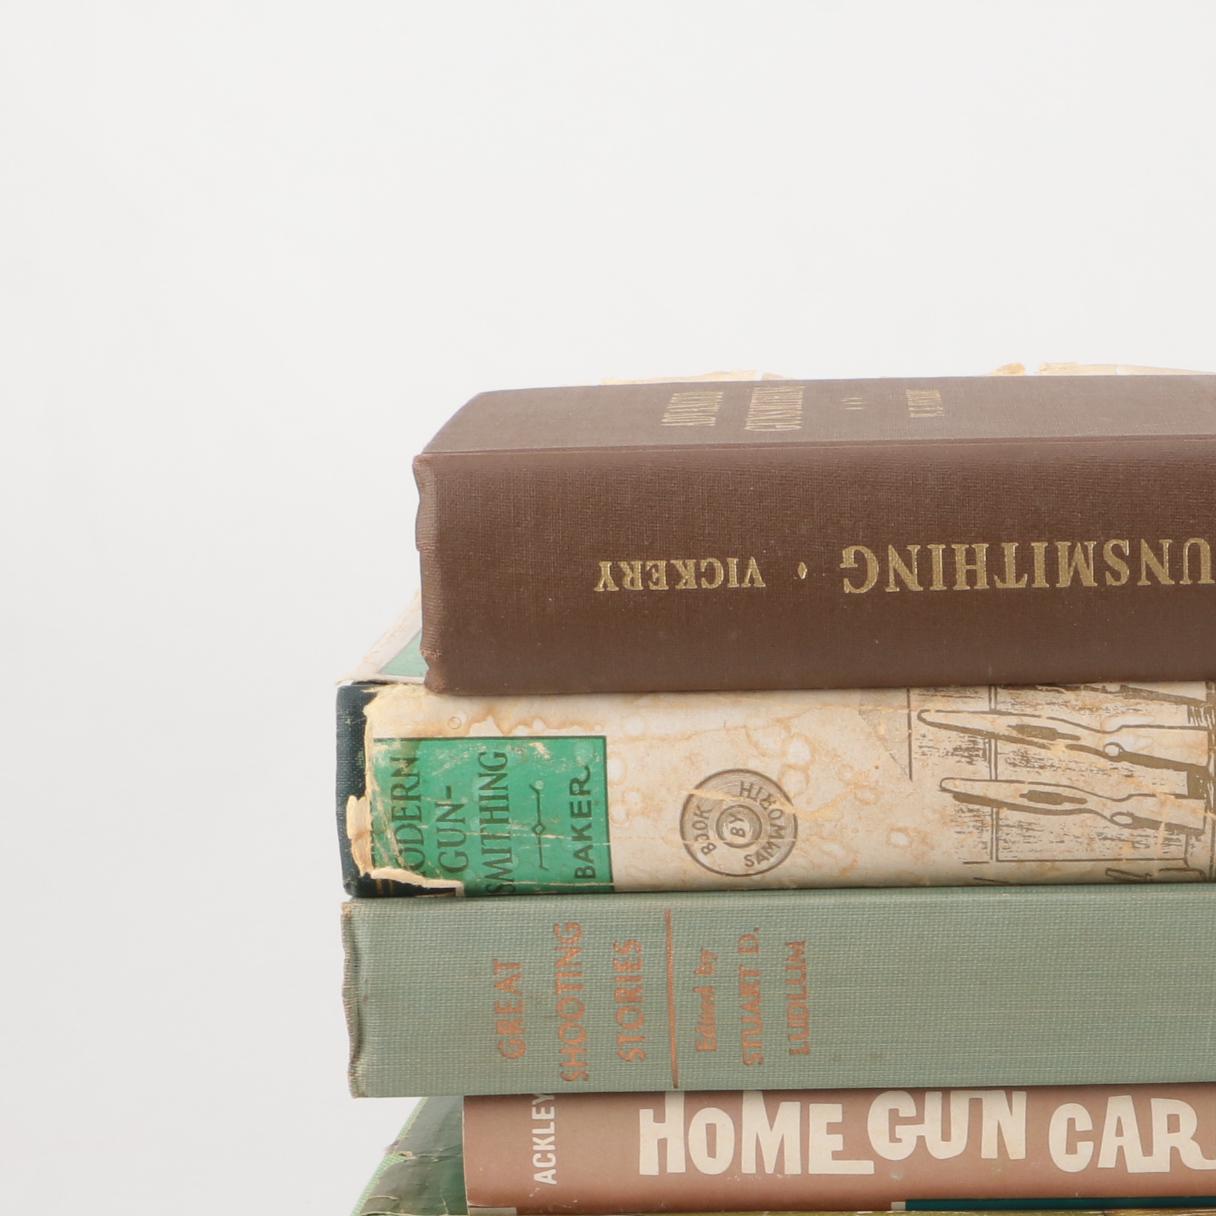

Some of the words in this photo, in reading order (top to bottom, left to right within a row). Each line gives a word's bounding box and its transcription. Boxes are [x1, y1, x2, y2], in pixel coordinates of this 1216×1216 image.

[594, 557, 766, 592] VICKERY
[390, 756, 426, 872] ODERN
[434, 786, 470, 874] GUN-
[477, 751, 517, 893] SMITHING
[569, 765, 597, 879] BAKER
[692, 804, 718, 856] BOOK
[727, 812, 747, 838] BY
[738, 927, 762, 955] D.
[492, 959, 527, 1060] GREAT
[554, 921, 591, 1082] SHOOTING
[612, 938, 646, 1062] STORIES
[738, 964, 765, 1066] STUART
[784, 940, 811, 1056] LUDLUM
[532, 1094, 557, 1185] ACKLEY
[638, 1089, 875, 1176] HOME
[867, 1089, 1028, 1161] GUN
